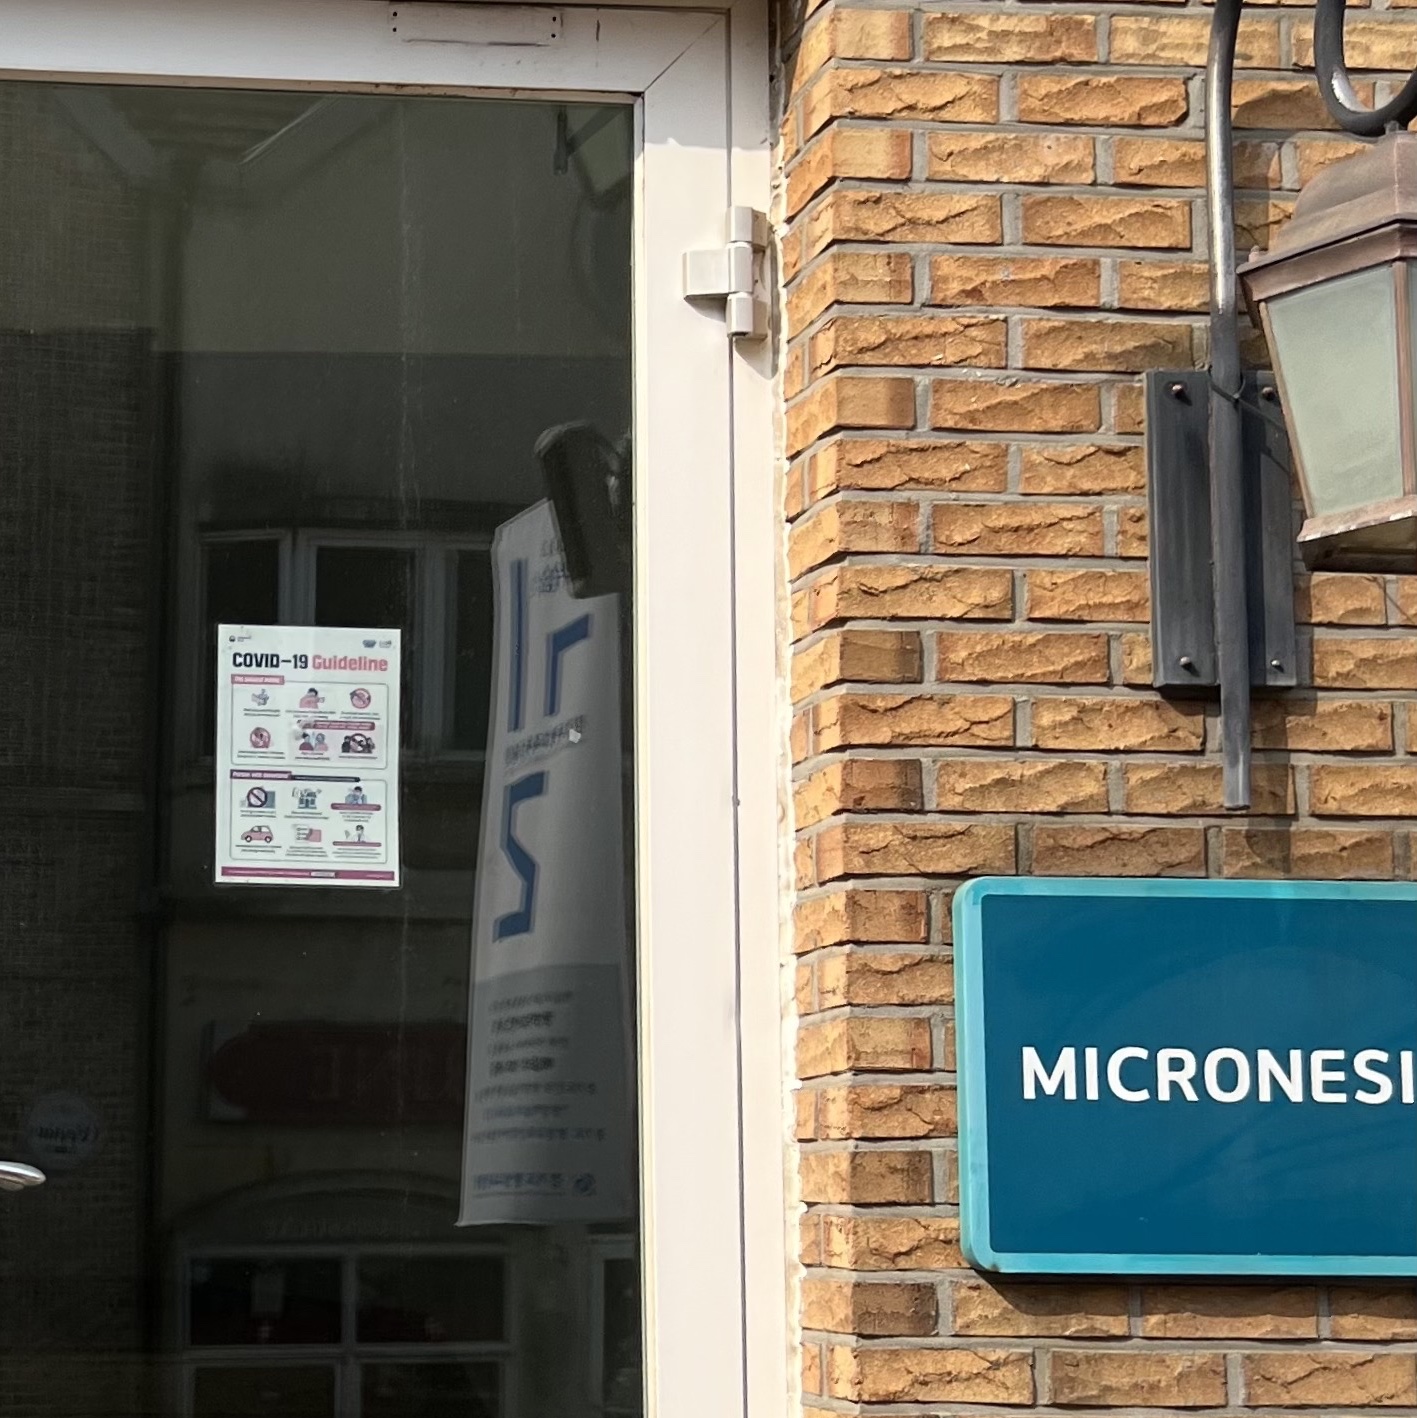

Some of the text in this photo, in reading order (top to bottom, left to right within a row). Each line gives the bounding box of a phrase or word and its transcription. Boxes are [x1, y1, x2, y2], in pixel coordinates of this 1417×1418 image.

[232, 652, 388, 672] COVID-19 Guideline
[1022, 1046, 1415, 1105] MICRONESI
